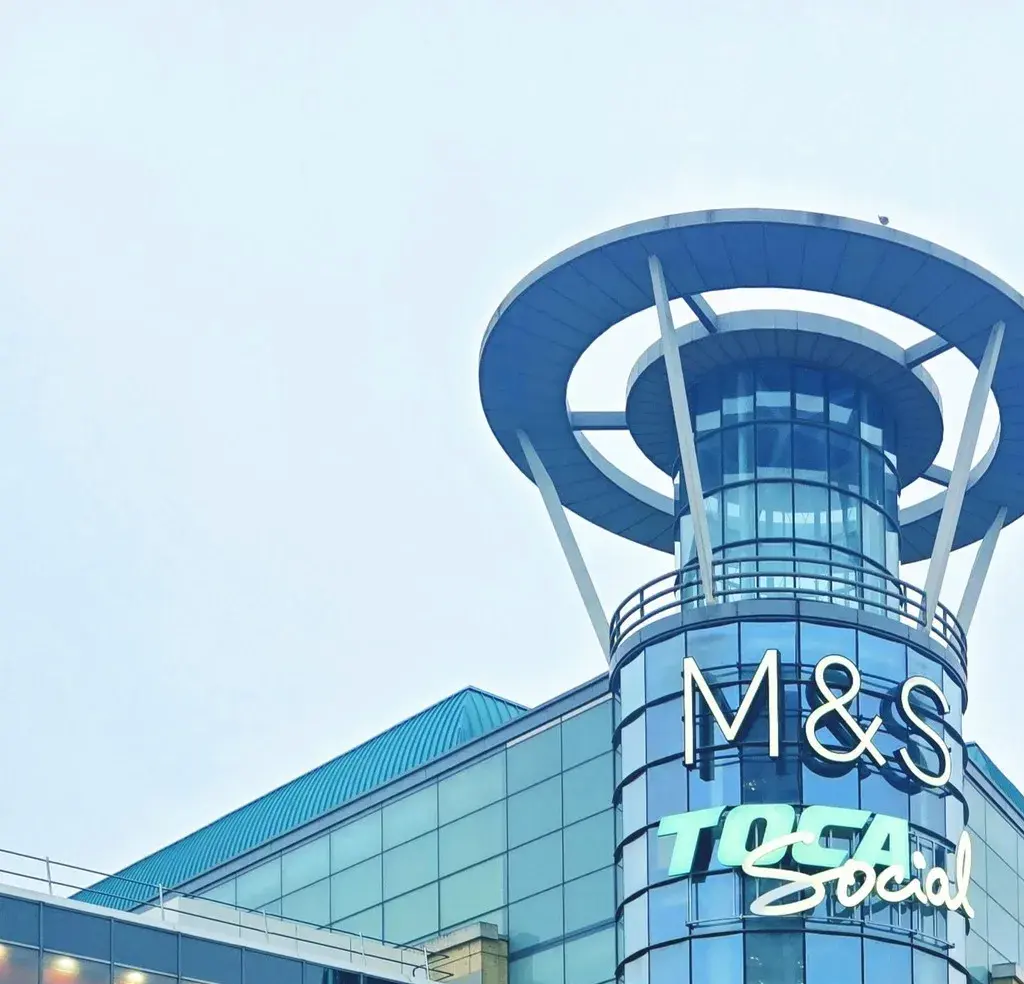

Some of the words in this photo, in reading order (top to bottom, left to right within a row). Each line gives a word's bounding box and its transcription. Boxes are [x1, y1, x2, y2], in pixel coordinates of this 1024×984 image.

[683, 649, 952, 788] M&S
[657, 804, 911, 881] TOCA
[742, 830, 975, 919] Social
